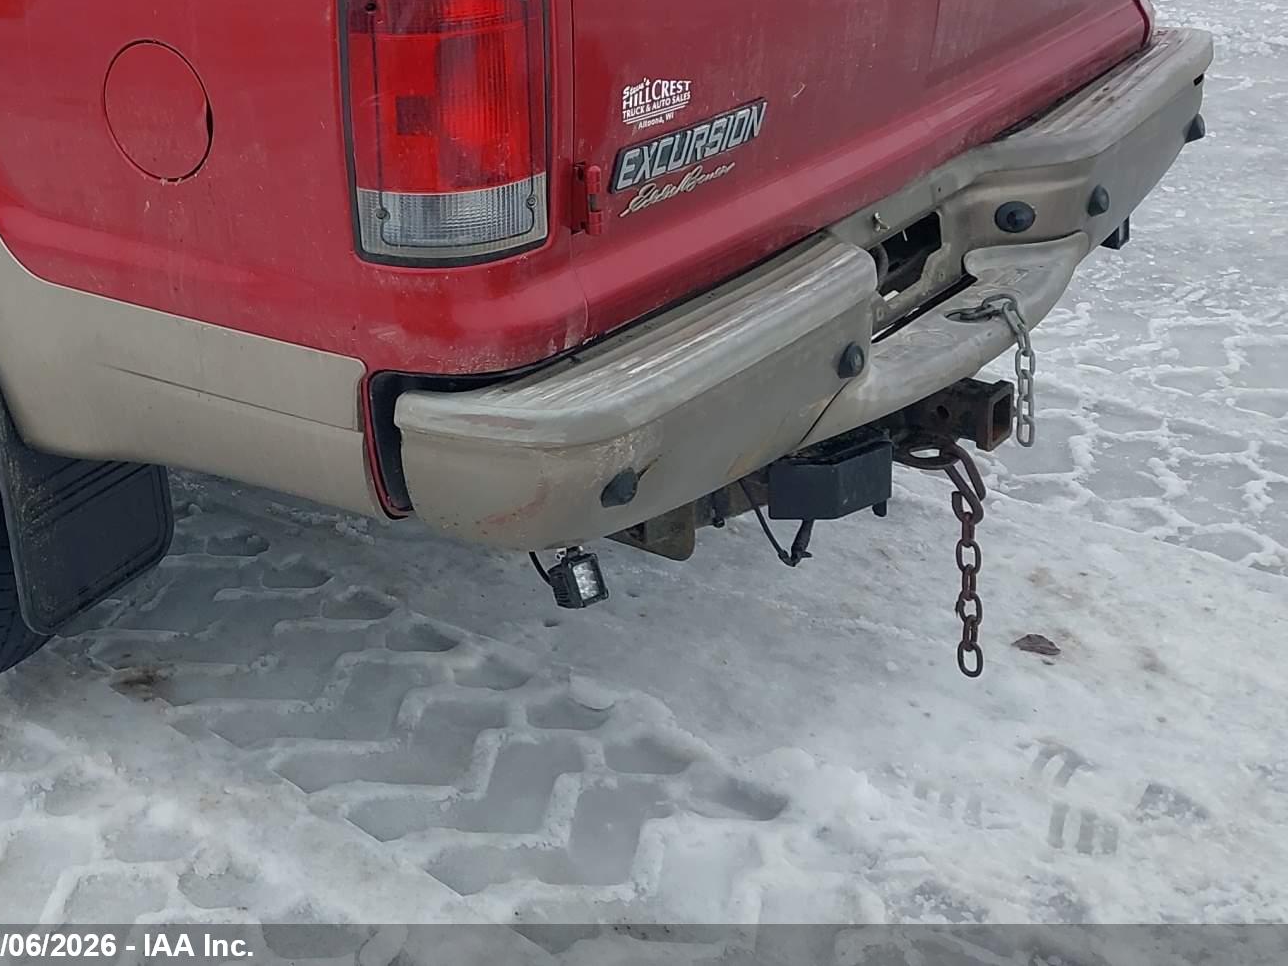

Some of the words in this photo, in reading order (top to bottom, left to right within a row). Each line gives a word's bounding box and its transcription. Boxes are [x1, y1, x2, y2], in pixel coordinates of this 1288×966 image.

[622, 79, 692, 110] HILLCREST
[622, 105, 645, 119] TRUCK
[645, 104, 652, 112] &
[651, 97, 672, 111] AUTO
[671, 91, 691, 105] SALES
[616, 101, 768, 191] EXCURSION
